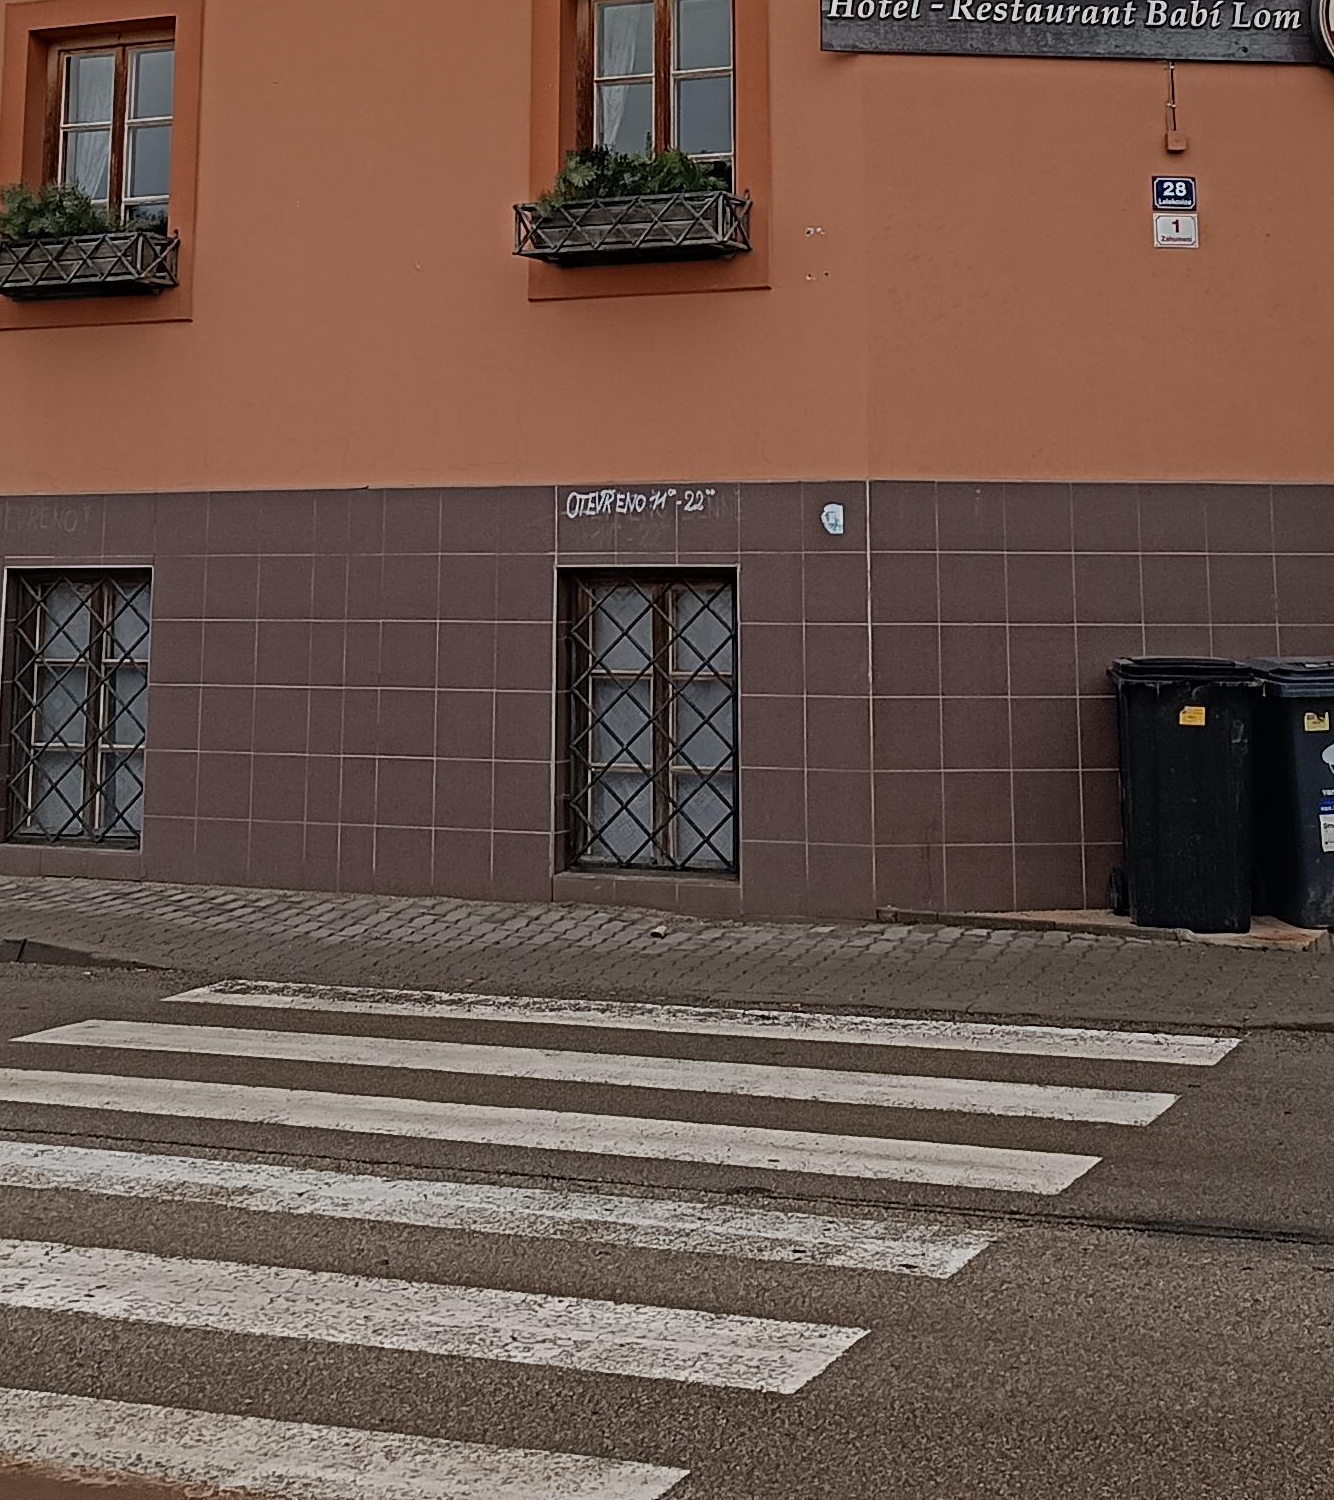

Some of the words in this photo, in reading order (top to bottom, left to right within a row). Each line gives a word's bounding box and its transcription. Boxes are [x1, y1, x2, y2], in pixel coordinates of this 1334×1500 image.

[1145, 0, 1225, 28] Babí
[1231, 1, 1302, 30] Lom
[1162, 181, 1187, 197] 28
[1171, 219, 1180, 233] 1
